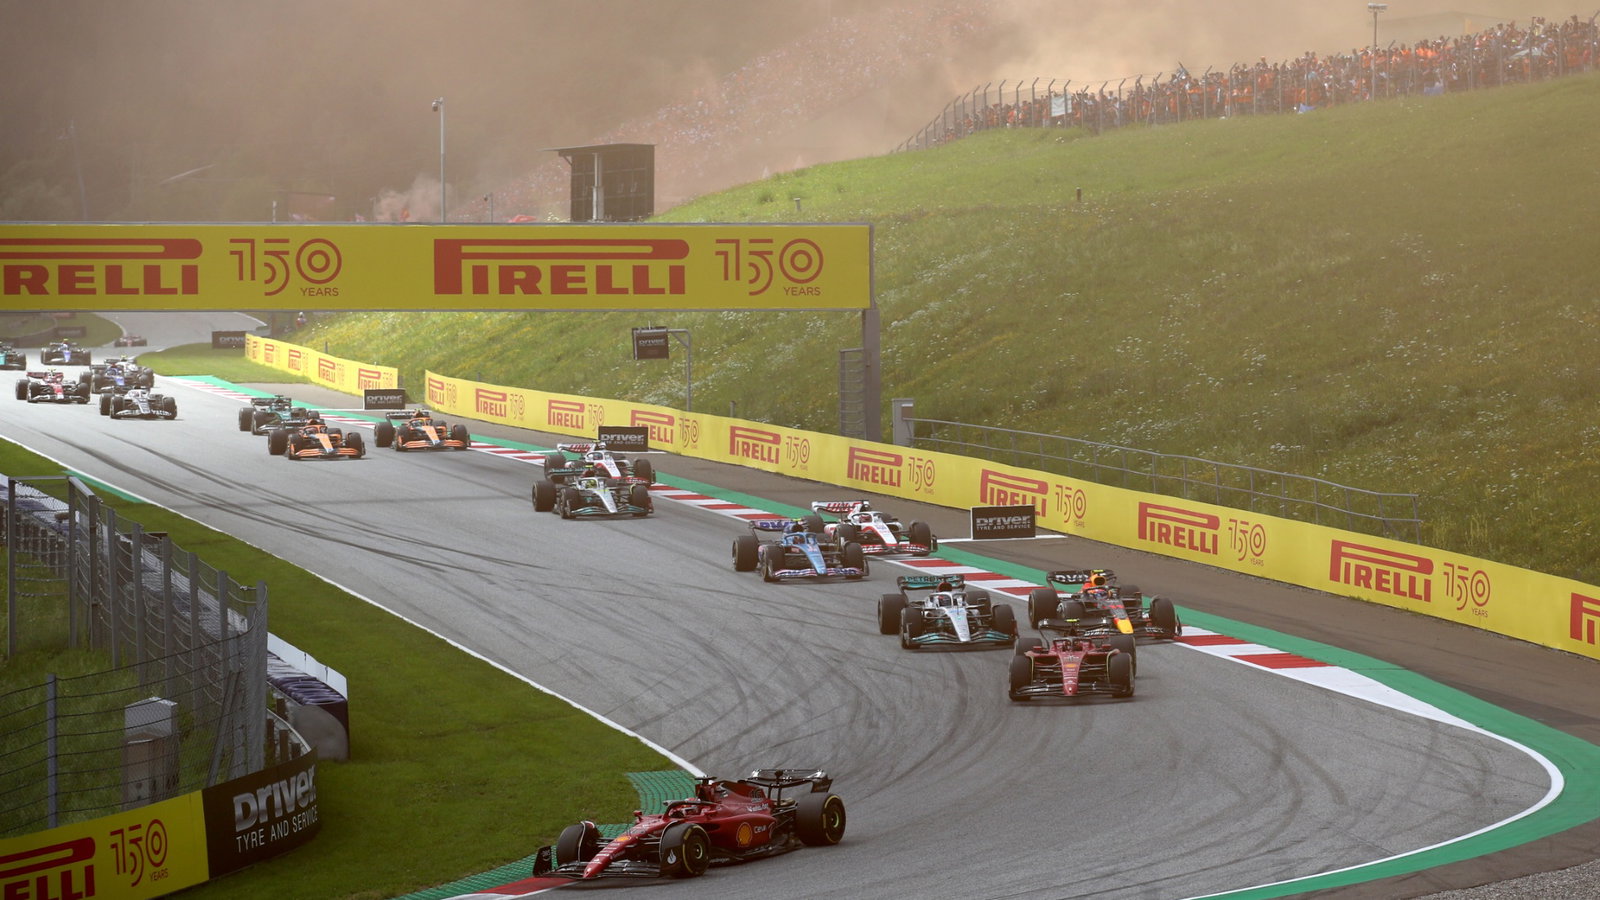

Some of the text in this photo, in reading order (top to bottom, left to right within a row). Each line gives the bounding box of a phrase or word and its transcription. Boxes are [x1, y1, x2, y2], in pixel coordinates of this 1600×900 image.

[229, 238, 342, 296] 150
[434, 238, 824, 296] PIRELLI 150
[300, 287, 339, 296] YEARS
[783, 286, 821, 296] YEARS
[475, 388, 507, 417] PIRELLI
[547, 399, 585, 429] PIRELLI
[630, 410, 675, 444] PELLI
[729, 425, 810, 468] PIRELLI 150
[847, 446, 935, 491] PIRELLI 150
[1055, 484, 1087, 523] 150
[1138, 501, 1266, 561] PIRELLI 150
[1329, 539, 1491, 611] PIRELLI 150
[1471, 607, 1488, 618] YEARS
[236, 804, 318, 853] TYRE AND SERVICE
[110, 819, 168, 887] 150
[150, 867, 169, 882] YEARS
